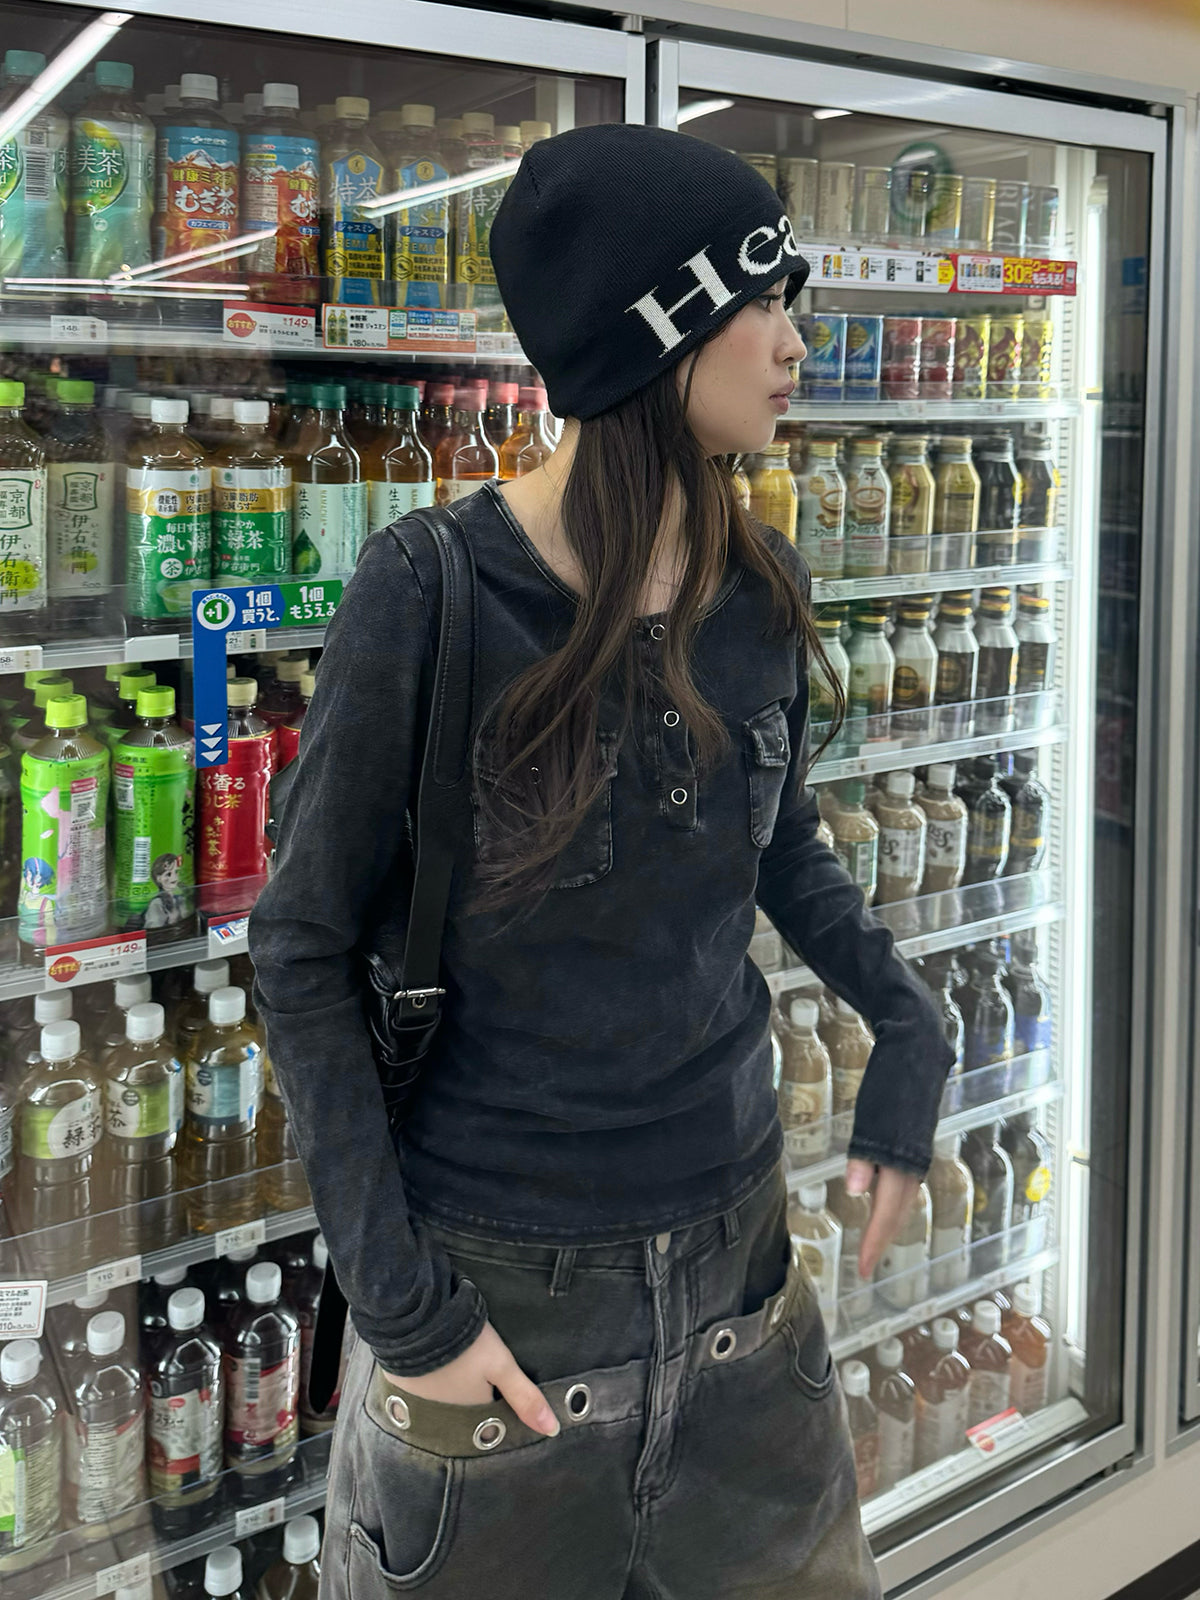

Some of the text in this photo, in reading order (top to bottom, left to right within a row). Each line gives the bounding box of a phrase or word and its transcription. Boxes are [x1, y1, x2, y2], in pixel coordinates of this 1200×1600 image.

[175, 185, 237, 216] むぎ茶
[404, 228, 444, 237] ジャスミン
[8, 489, 25, 519] 京都
[388, 488, 402, 518] 生茶
[165, 561, 181, 577] 茶
[246, 590, 272, 608] 1個
[299, 586, 324, 603] 1個
[206, 602, 222, 620] +1
[242, 607, 280, 624] 買うと、
[290, 601, 336, 619] もらえる
